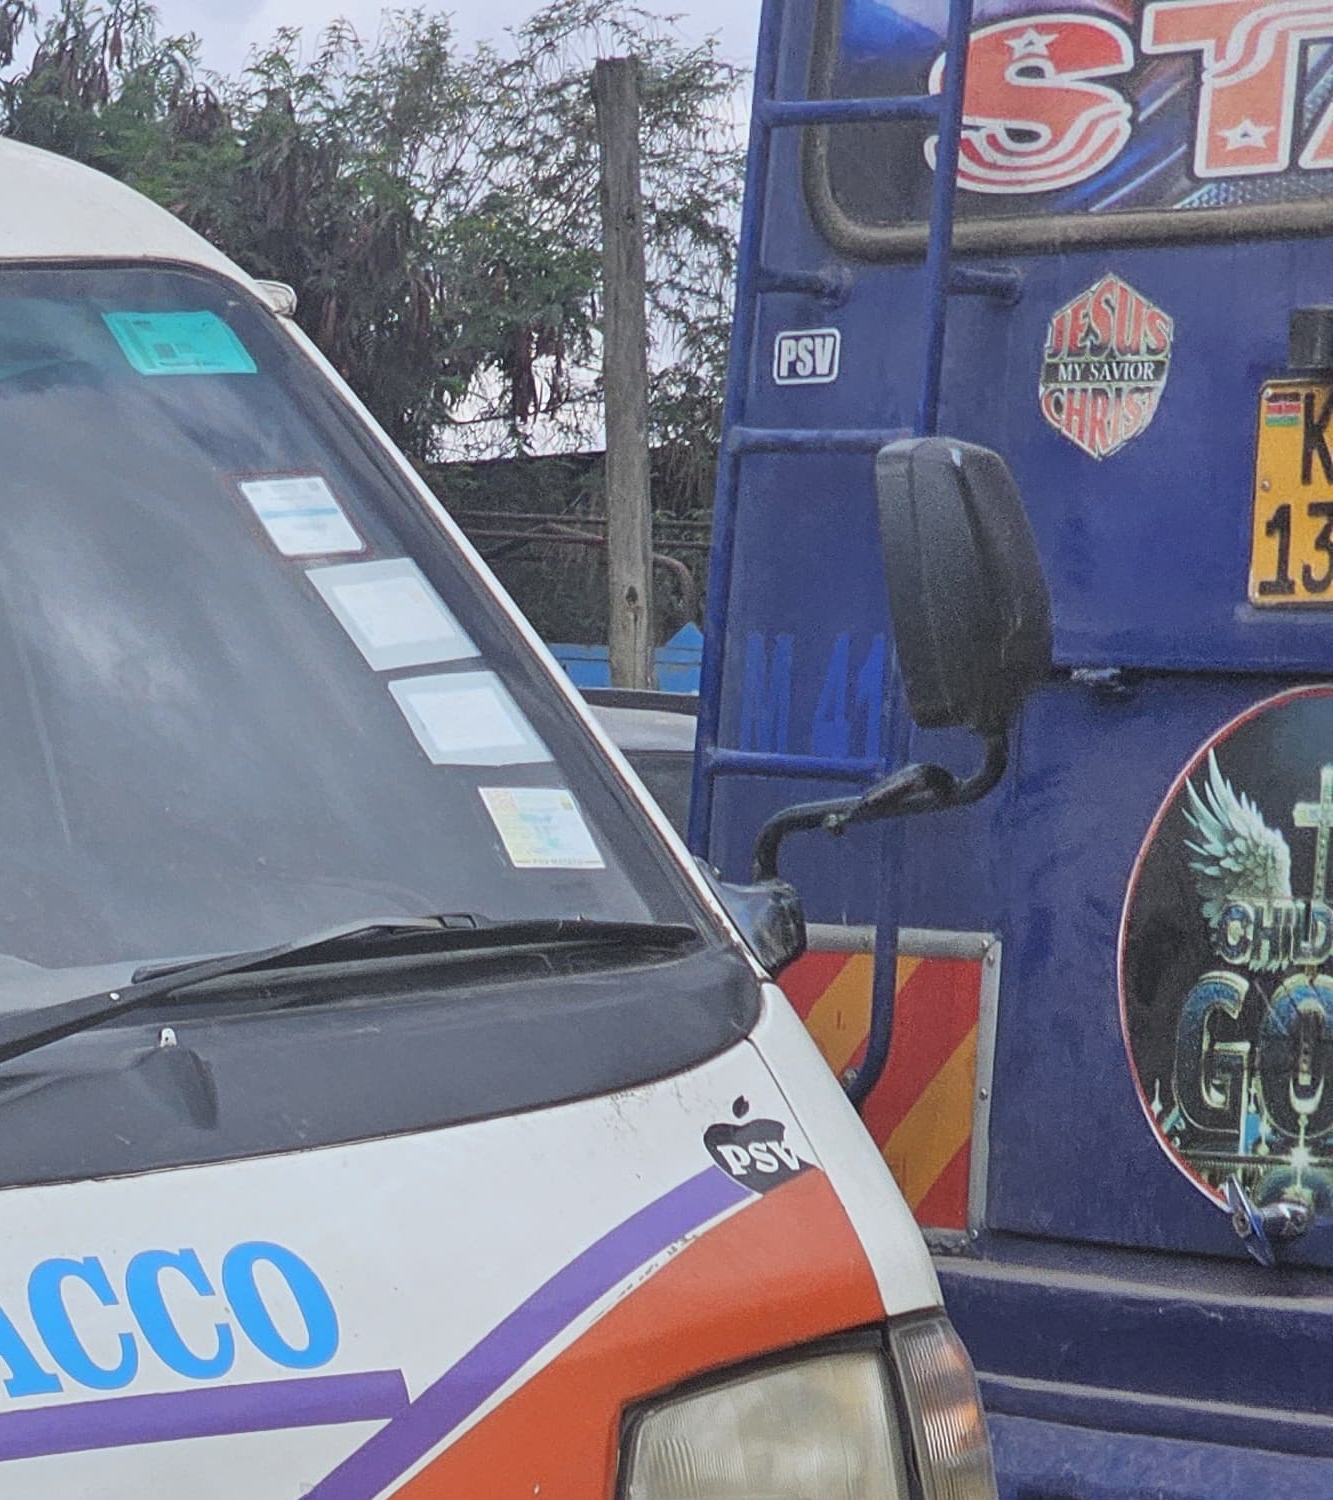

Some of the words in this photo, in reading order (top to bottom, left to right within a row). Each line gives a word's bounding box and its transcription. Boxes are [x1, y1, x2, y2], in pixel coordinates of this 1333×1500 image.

[923, 3, 1333, 194] ST
[1045, 279, 1172, 361] JESUS
[779, 335, 835, 377] PSV
[1058, 361, 1085, 381] MY
[1089, 361, 1156, 381] SAVIOR
[1042, 387, 1160, 452] CHRIST
[717, 1140, 801, 1175] PSV
